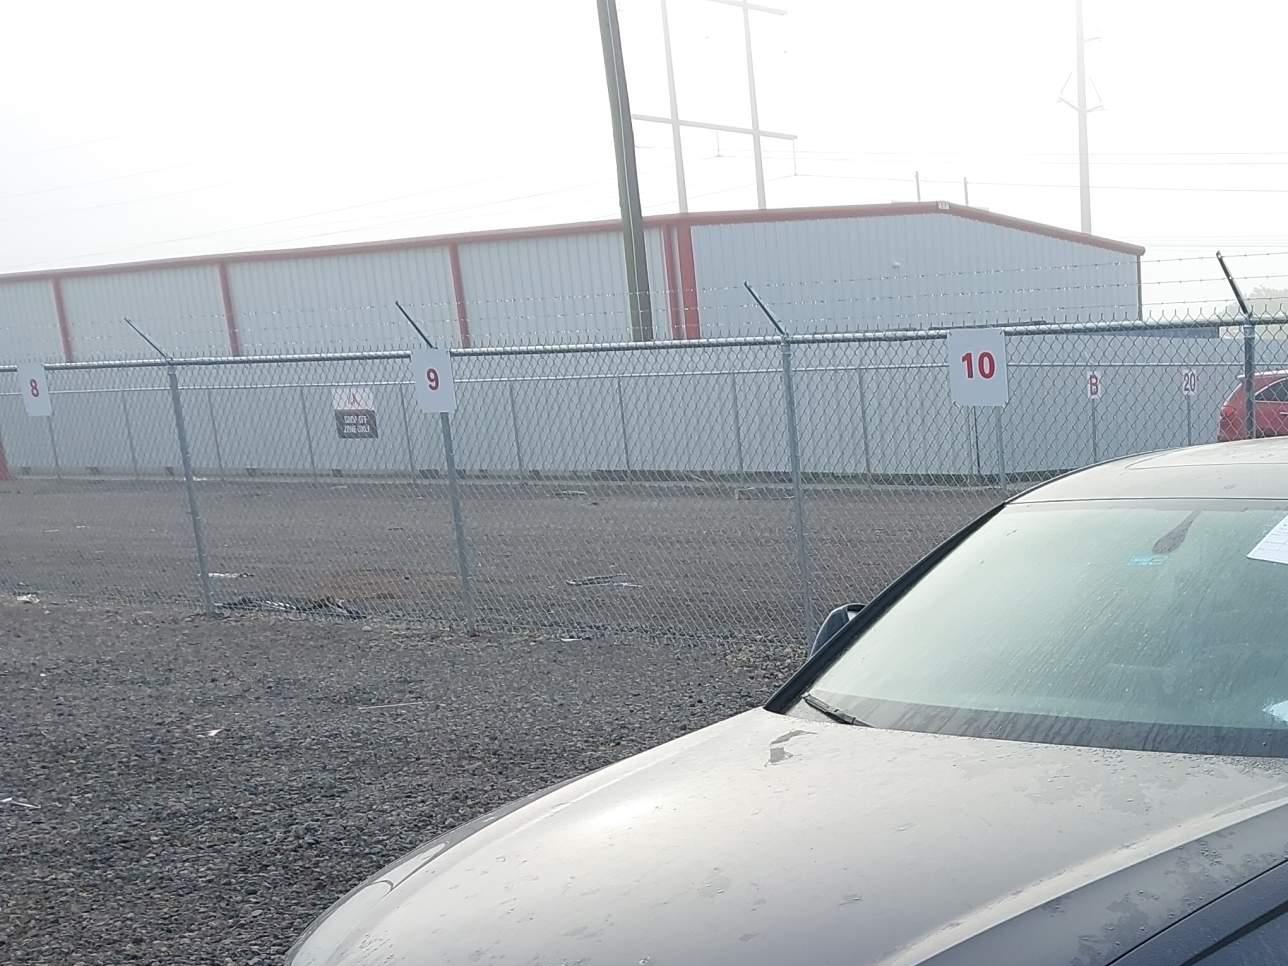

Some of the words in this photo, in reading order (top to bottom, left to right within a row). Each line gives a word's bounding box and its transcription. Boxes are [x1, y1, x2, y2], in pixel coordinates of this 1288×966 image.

[961, 351, 995, 379] 10
[30, 378, 40, 397] 8
[426, 368, 439, 391] 9
